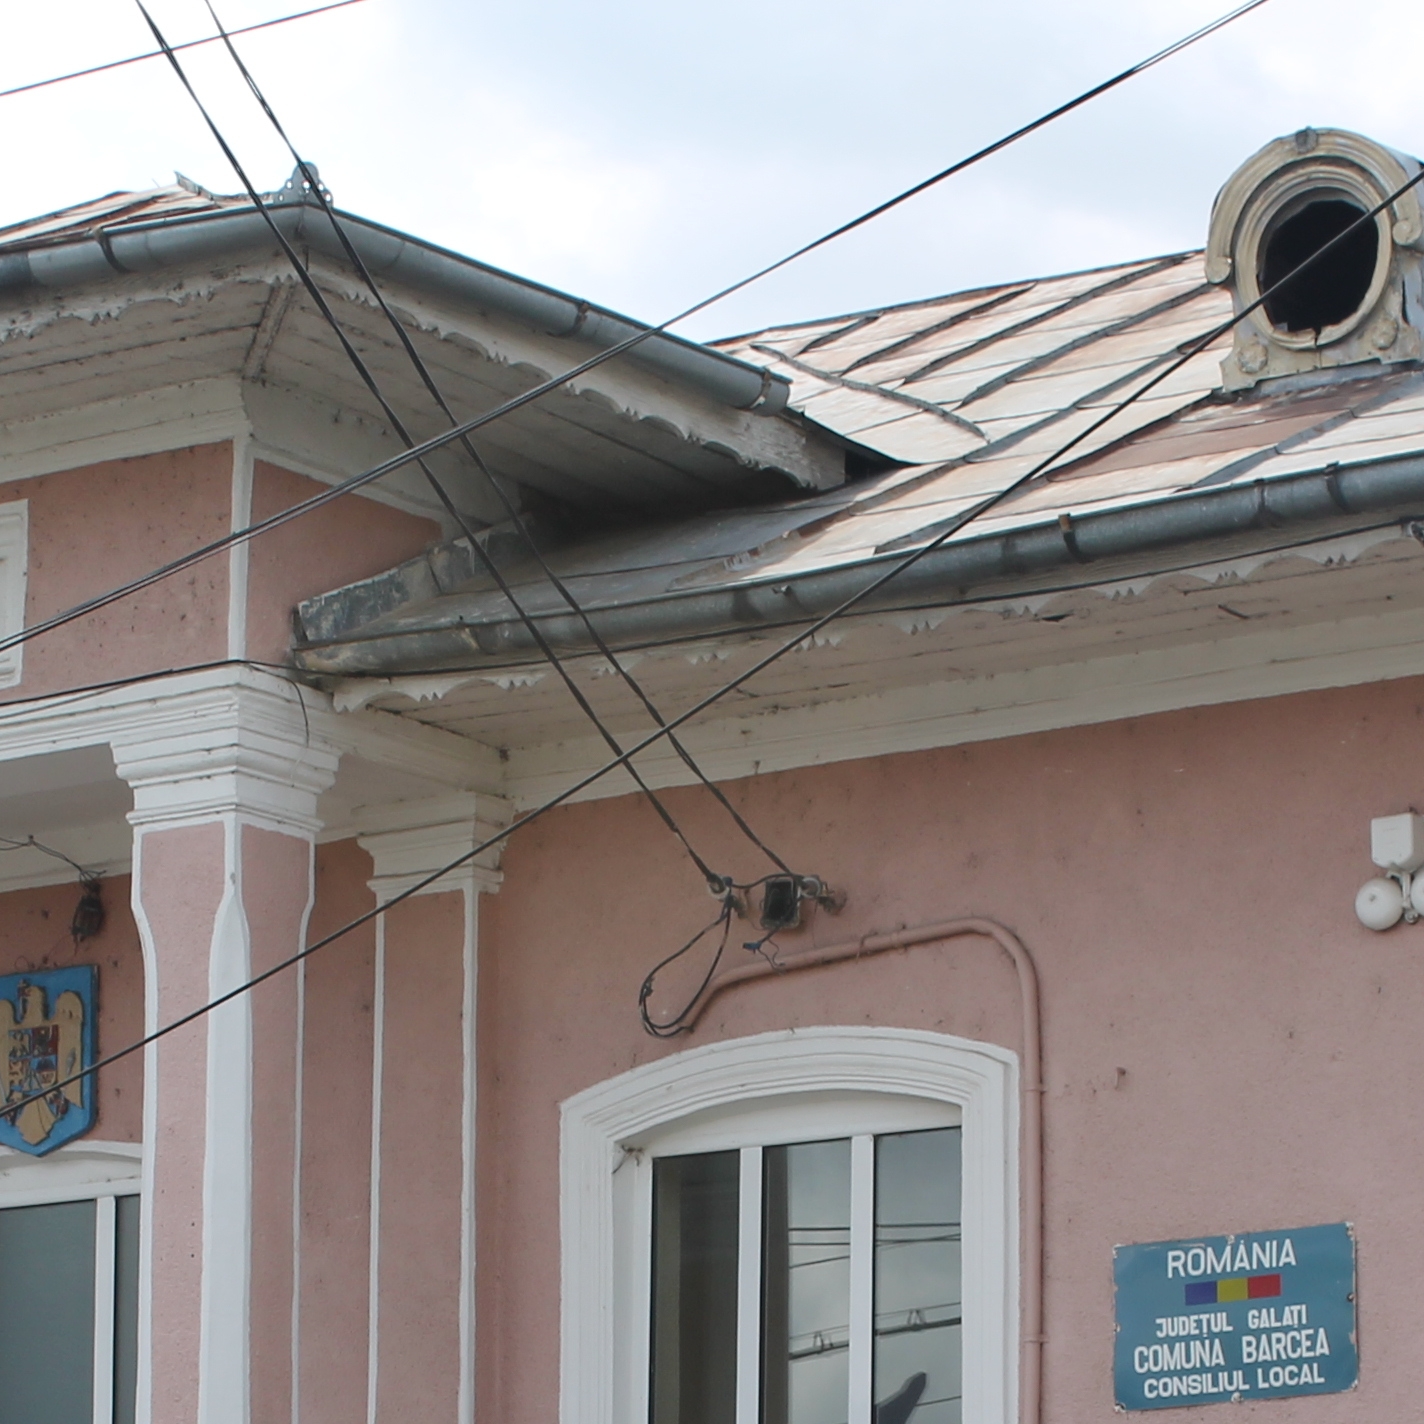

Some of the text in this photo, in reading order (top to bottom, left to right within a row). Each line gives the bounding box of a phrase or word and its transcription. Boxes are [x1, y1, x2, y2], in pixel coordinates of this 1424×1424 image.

[1134, 1328, 1330, 1374] COMUNA BARCEA
[1143, 1363, 1325, 1399] CONSILIUL LOCAL
